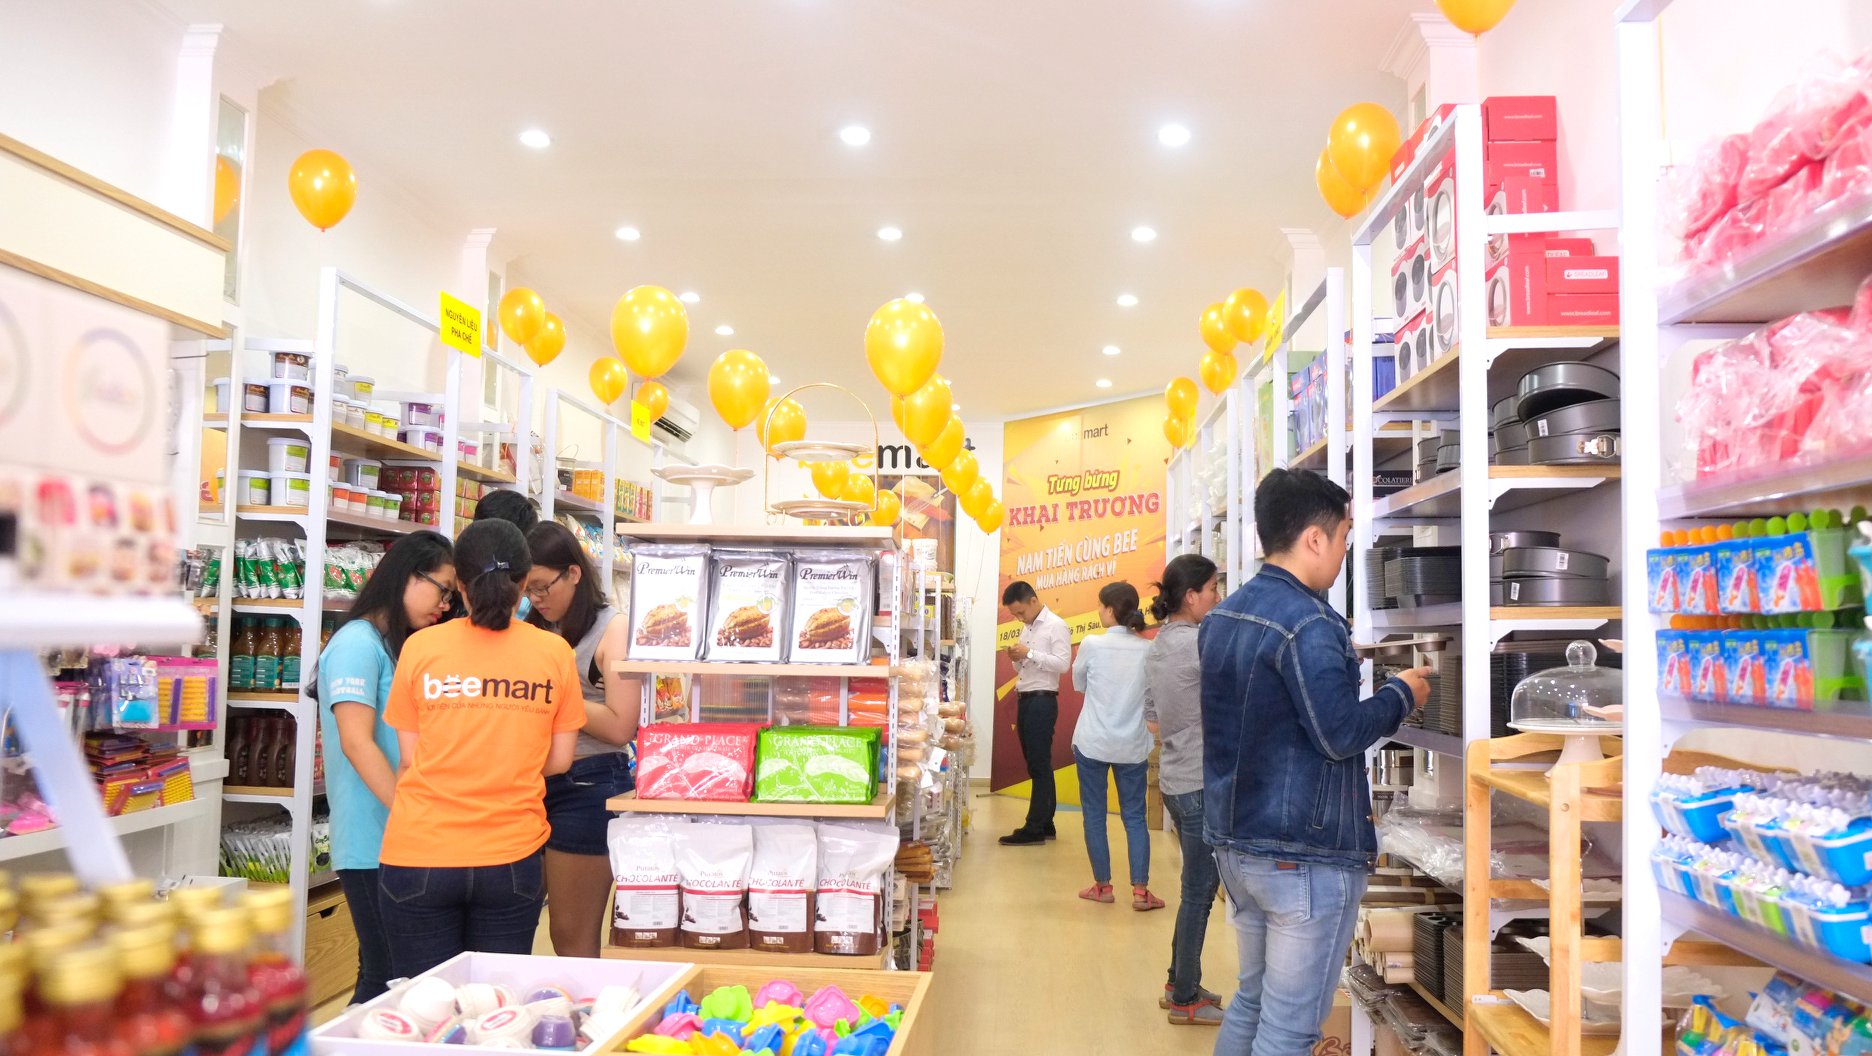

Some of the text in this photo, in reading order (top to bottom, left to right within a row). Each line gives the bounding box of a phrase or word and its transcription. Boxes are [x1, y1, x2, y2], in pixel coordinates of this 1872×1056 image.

[451, 326, 462, 339] PHA
[1048, 469, 1121, 497] Tưng bừng
[1008, 492, 1161, 526] KHAI TRƯƠNG
[1016, 551, 1044, 576] NAM
[1074, 535, 1111, 563] CÙNG
[1113, 528, 1139, 555] BEE
[799, 566, 858, 580] PremierWin
[1034, 573, 1054, 591] MUA
[1055, 568, 1080, 587] HÀNG
[423, 672, 553, 704] beemart
[704, 735, 742, 747] PLACE
